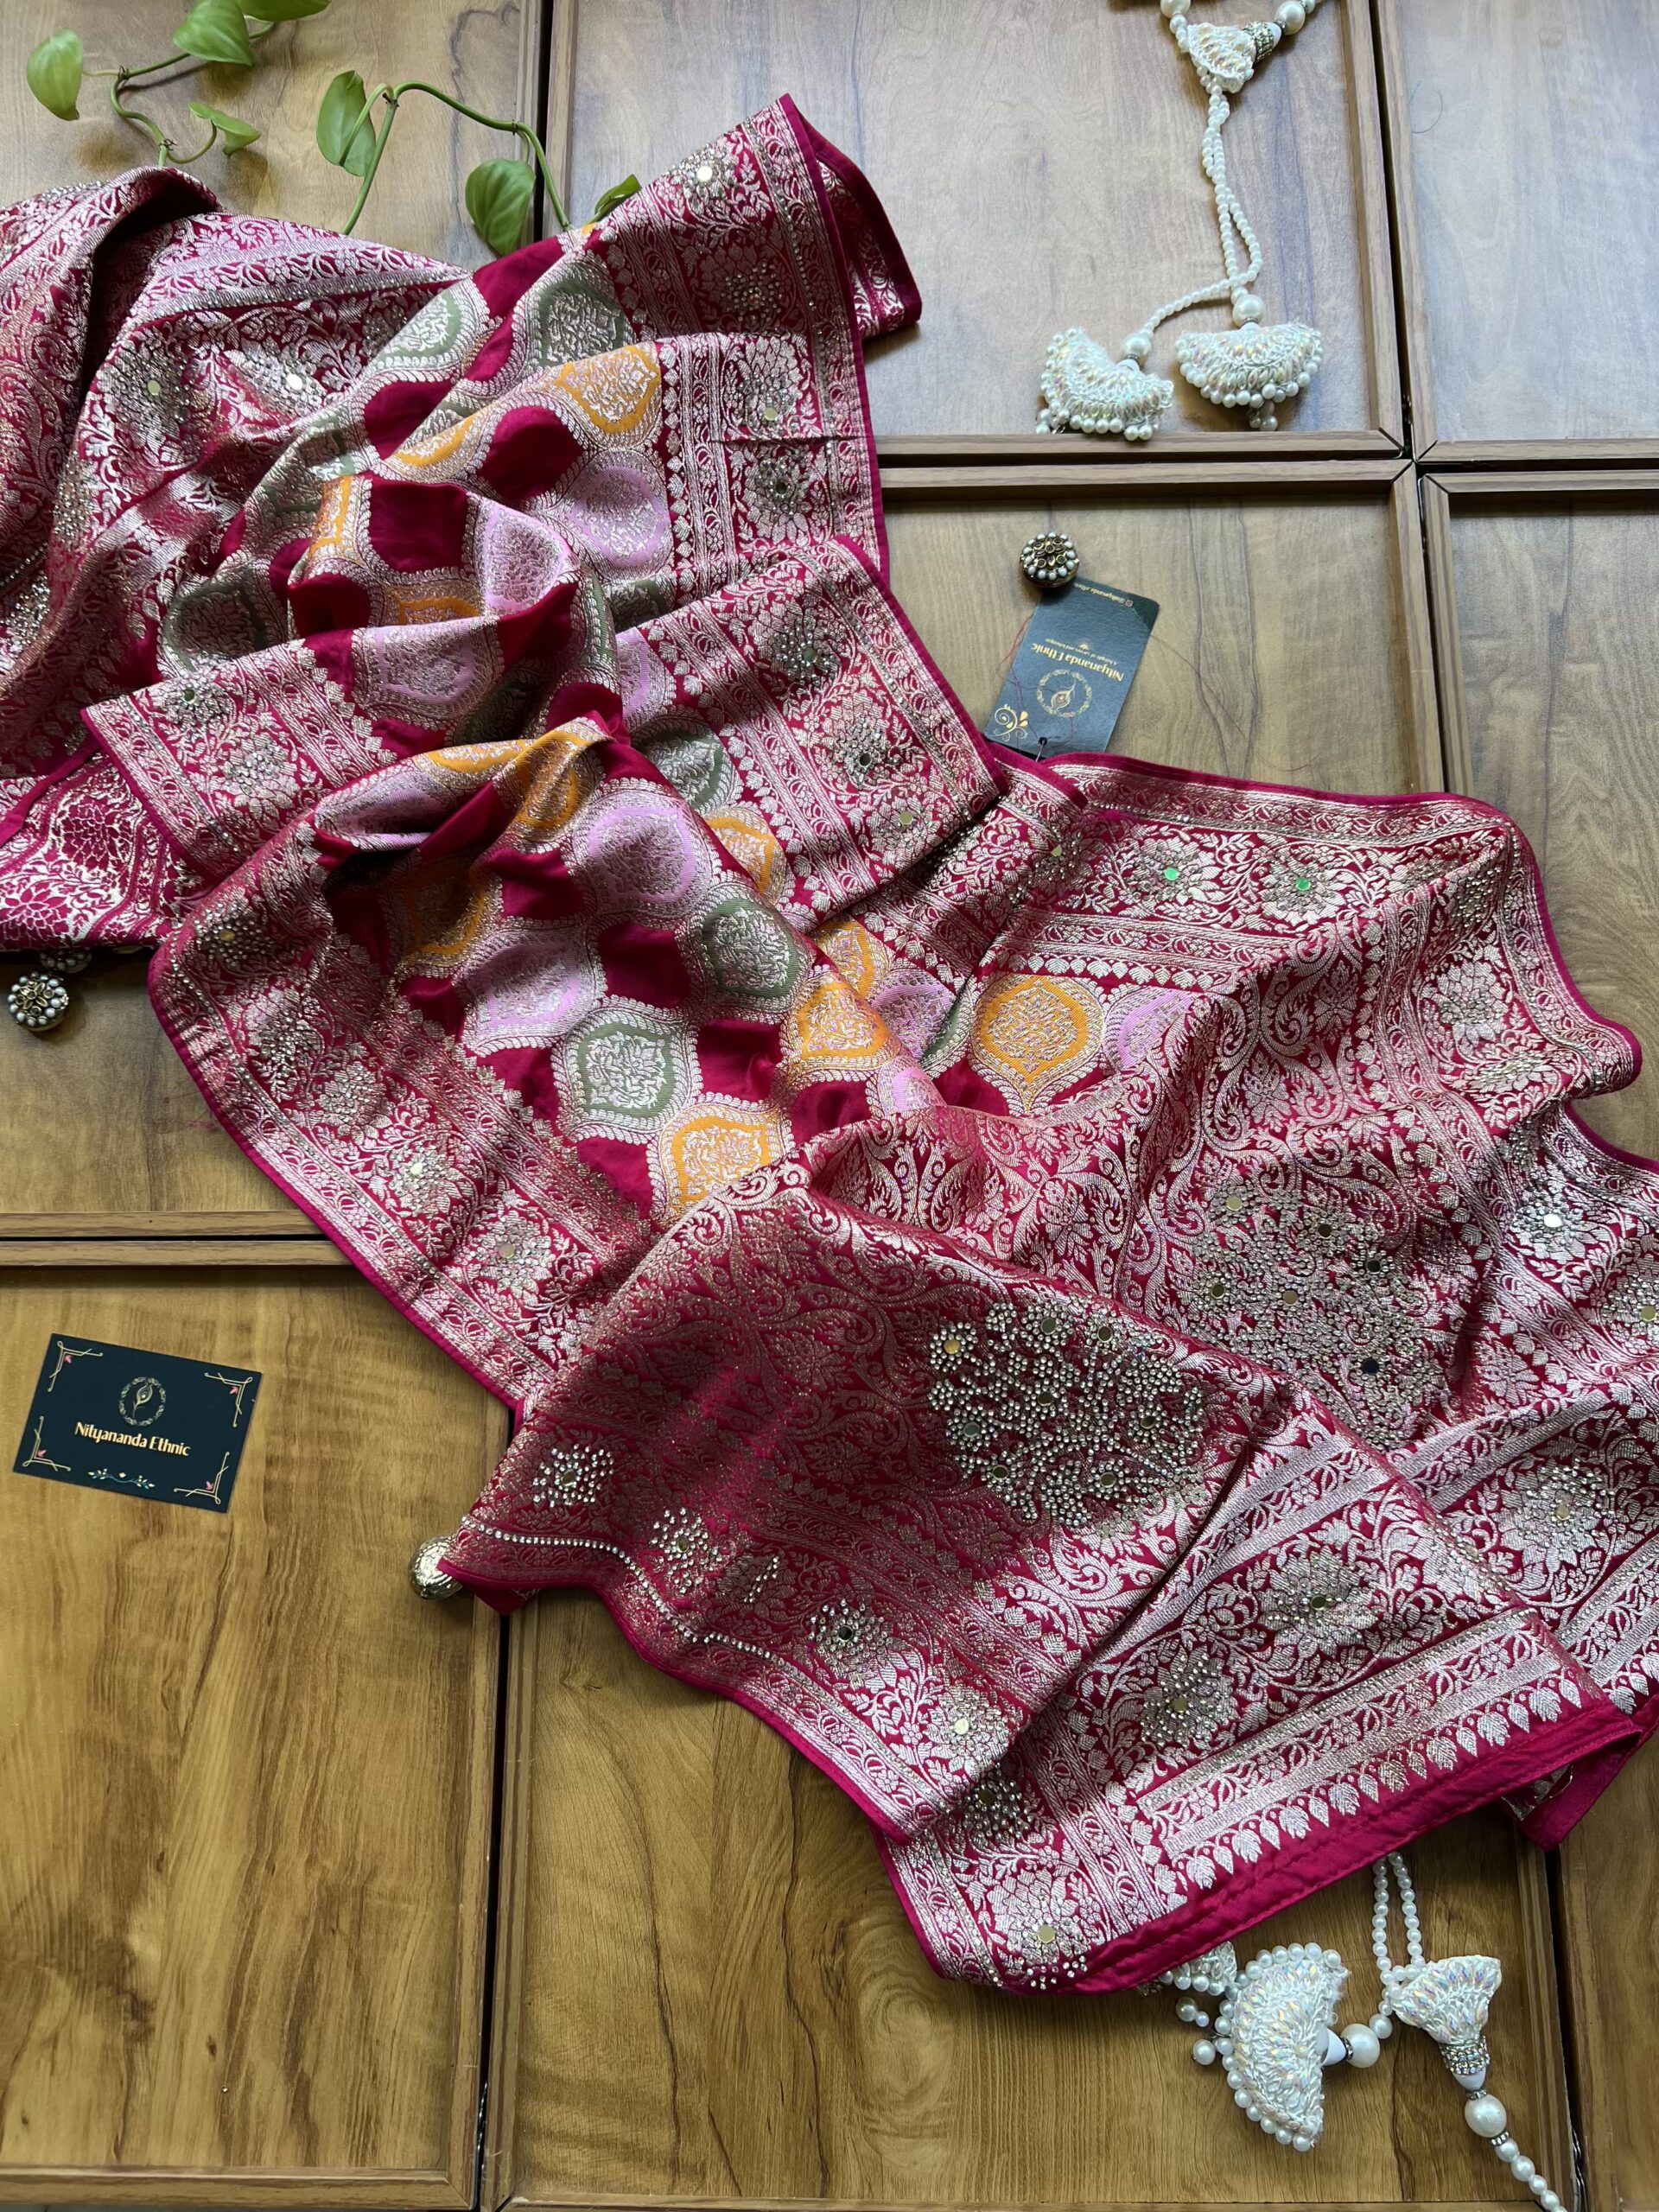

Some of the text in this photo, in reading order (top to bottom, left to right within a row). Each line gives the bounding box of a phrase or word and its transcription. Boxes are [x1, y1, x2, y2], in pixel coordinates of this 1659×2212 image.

[1031, 643, 1124, 682] Nityananda Ethnic
[74, 1421, 191, 1457] Nityananda Ethnic
